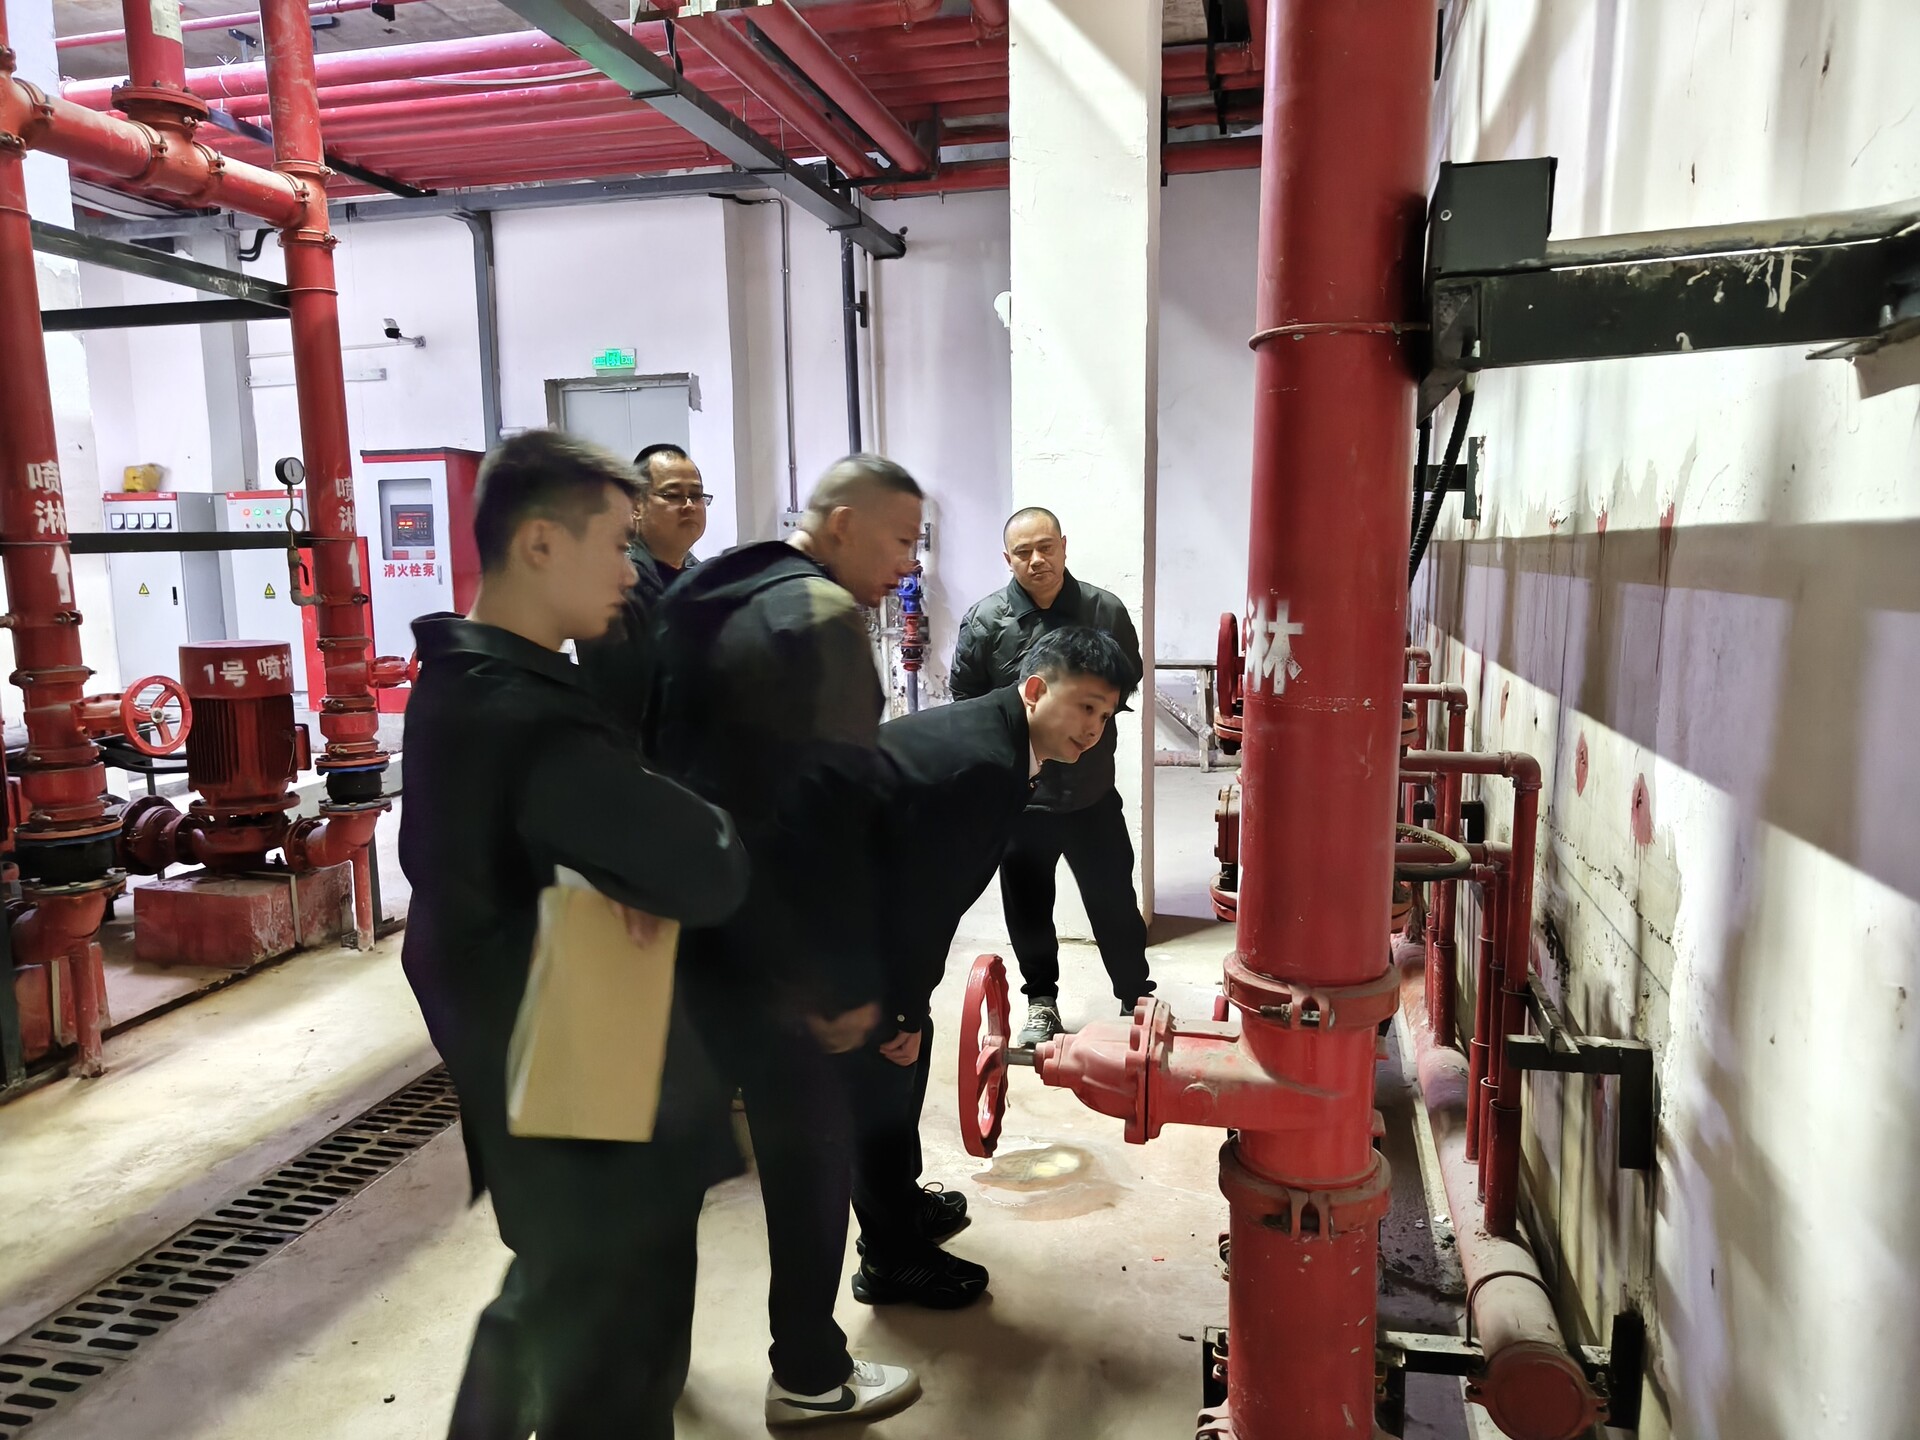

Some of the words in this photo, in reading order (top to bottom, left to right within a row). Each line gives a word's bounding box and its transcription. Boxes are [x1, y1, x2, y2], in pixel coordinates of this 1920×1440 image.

[26, 460, 67, 535] 喷淋
[384, 563, 435, 578] 消火栓泵
